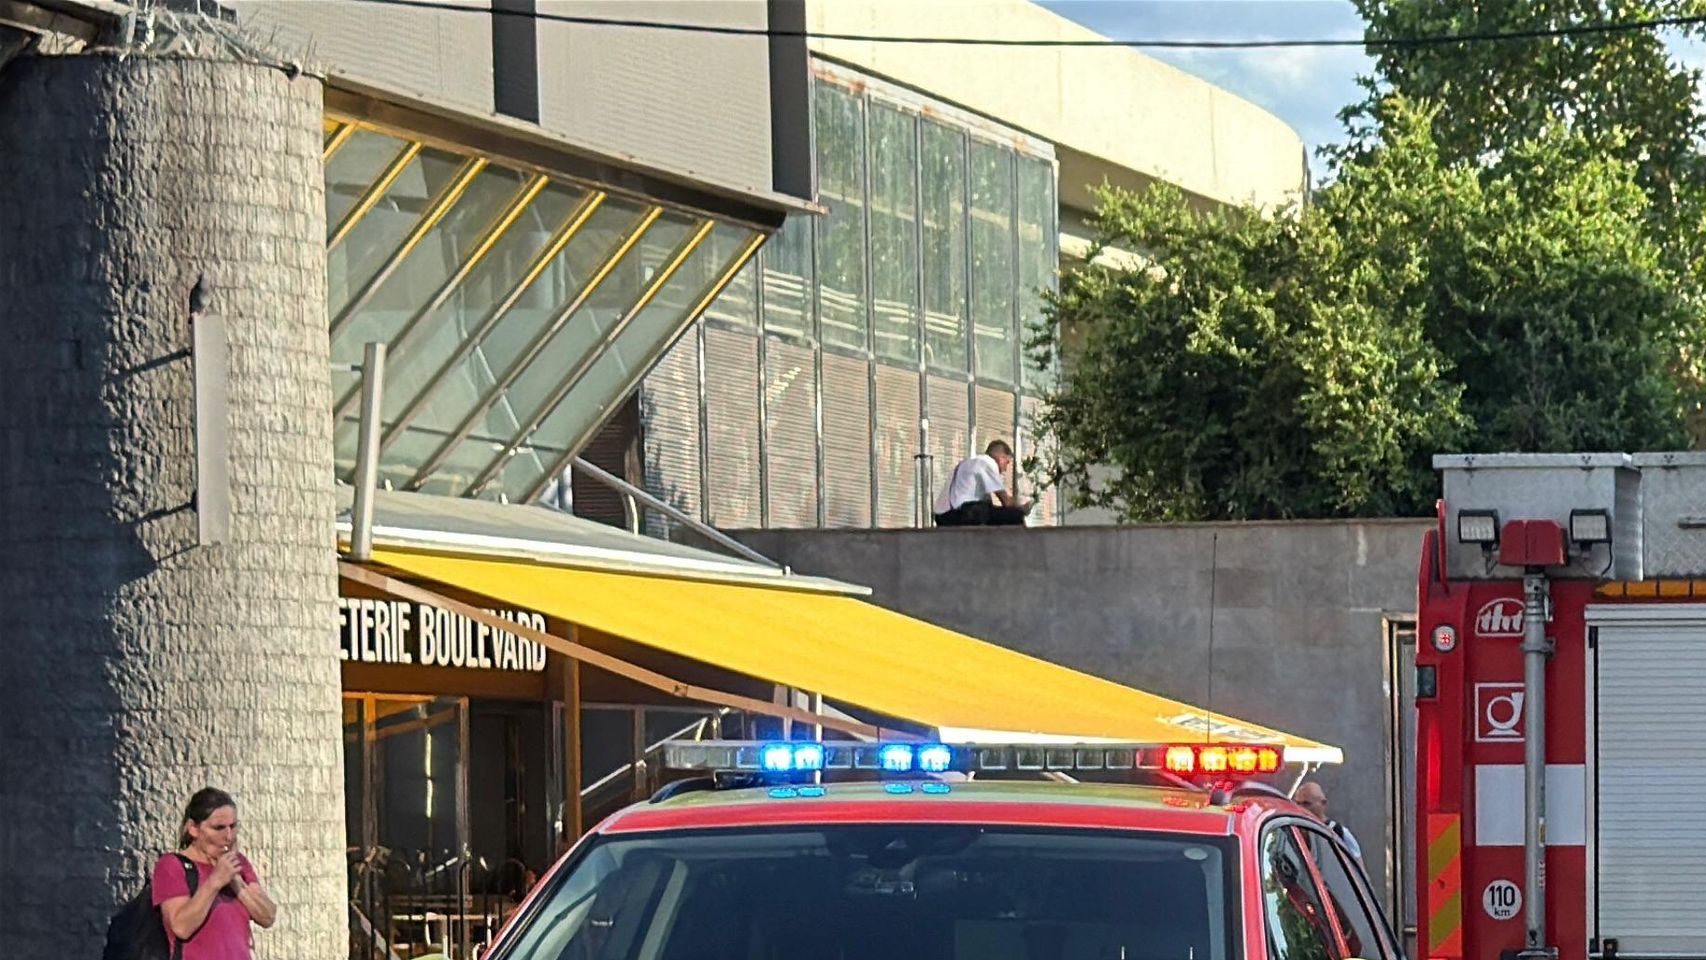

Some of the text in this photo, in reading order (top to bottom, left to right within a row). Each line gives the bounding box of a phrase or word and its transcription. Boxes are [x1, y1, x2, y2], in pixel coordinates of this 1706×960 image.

[419, 604, 547, 672] BOULEVARD
[1488, 885, 1516, 907] 110
[1494, 908, 1511, 917] km
